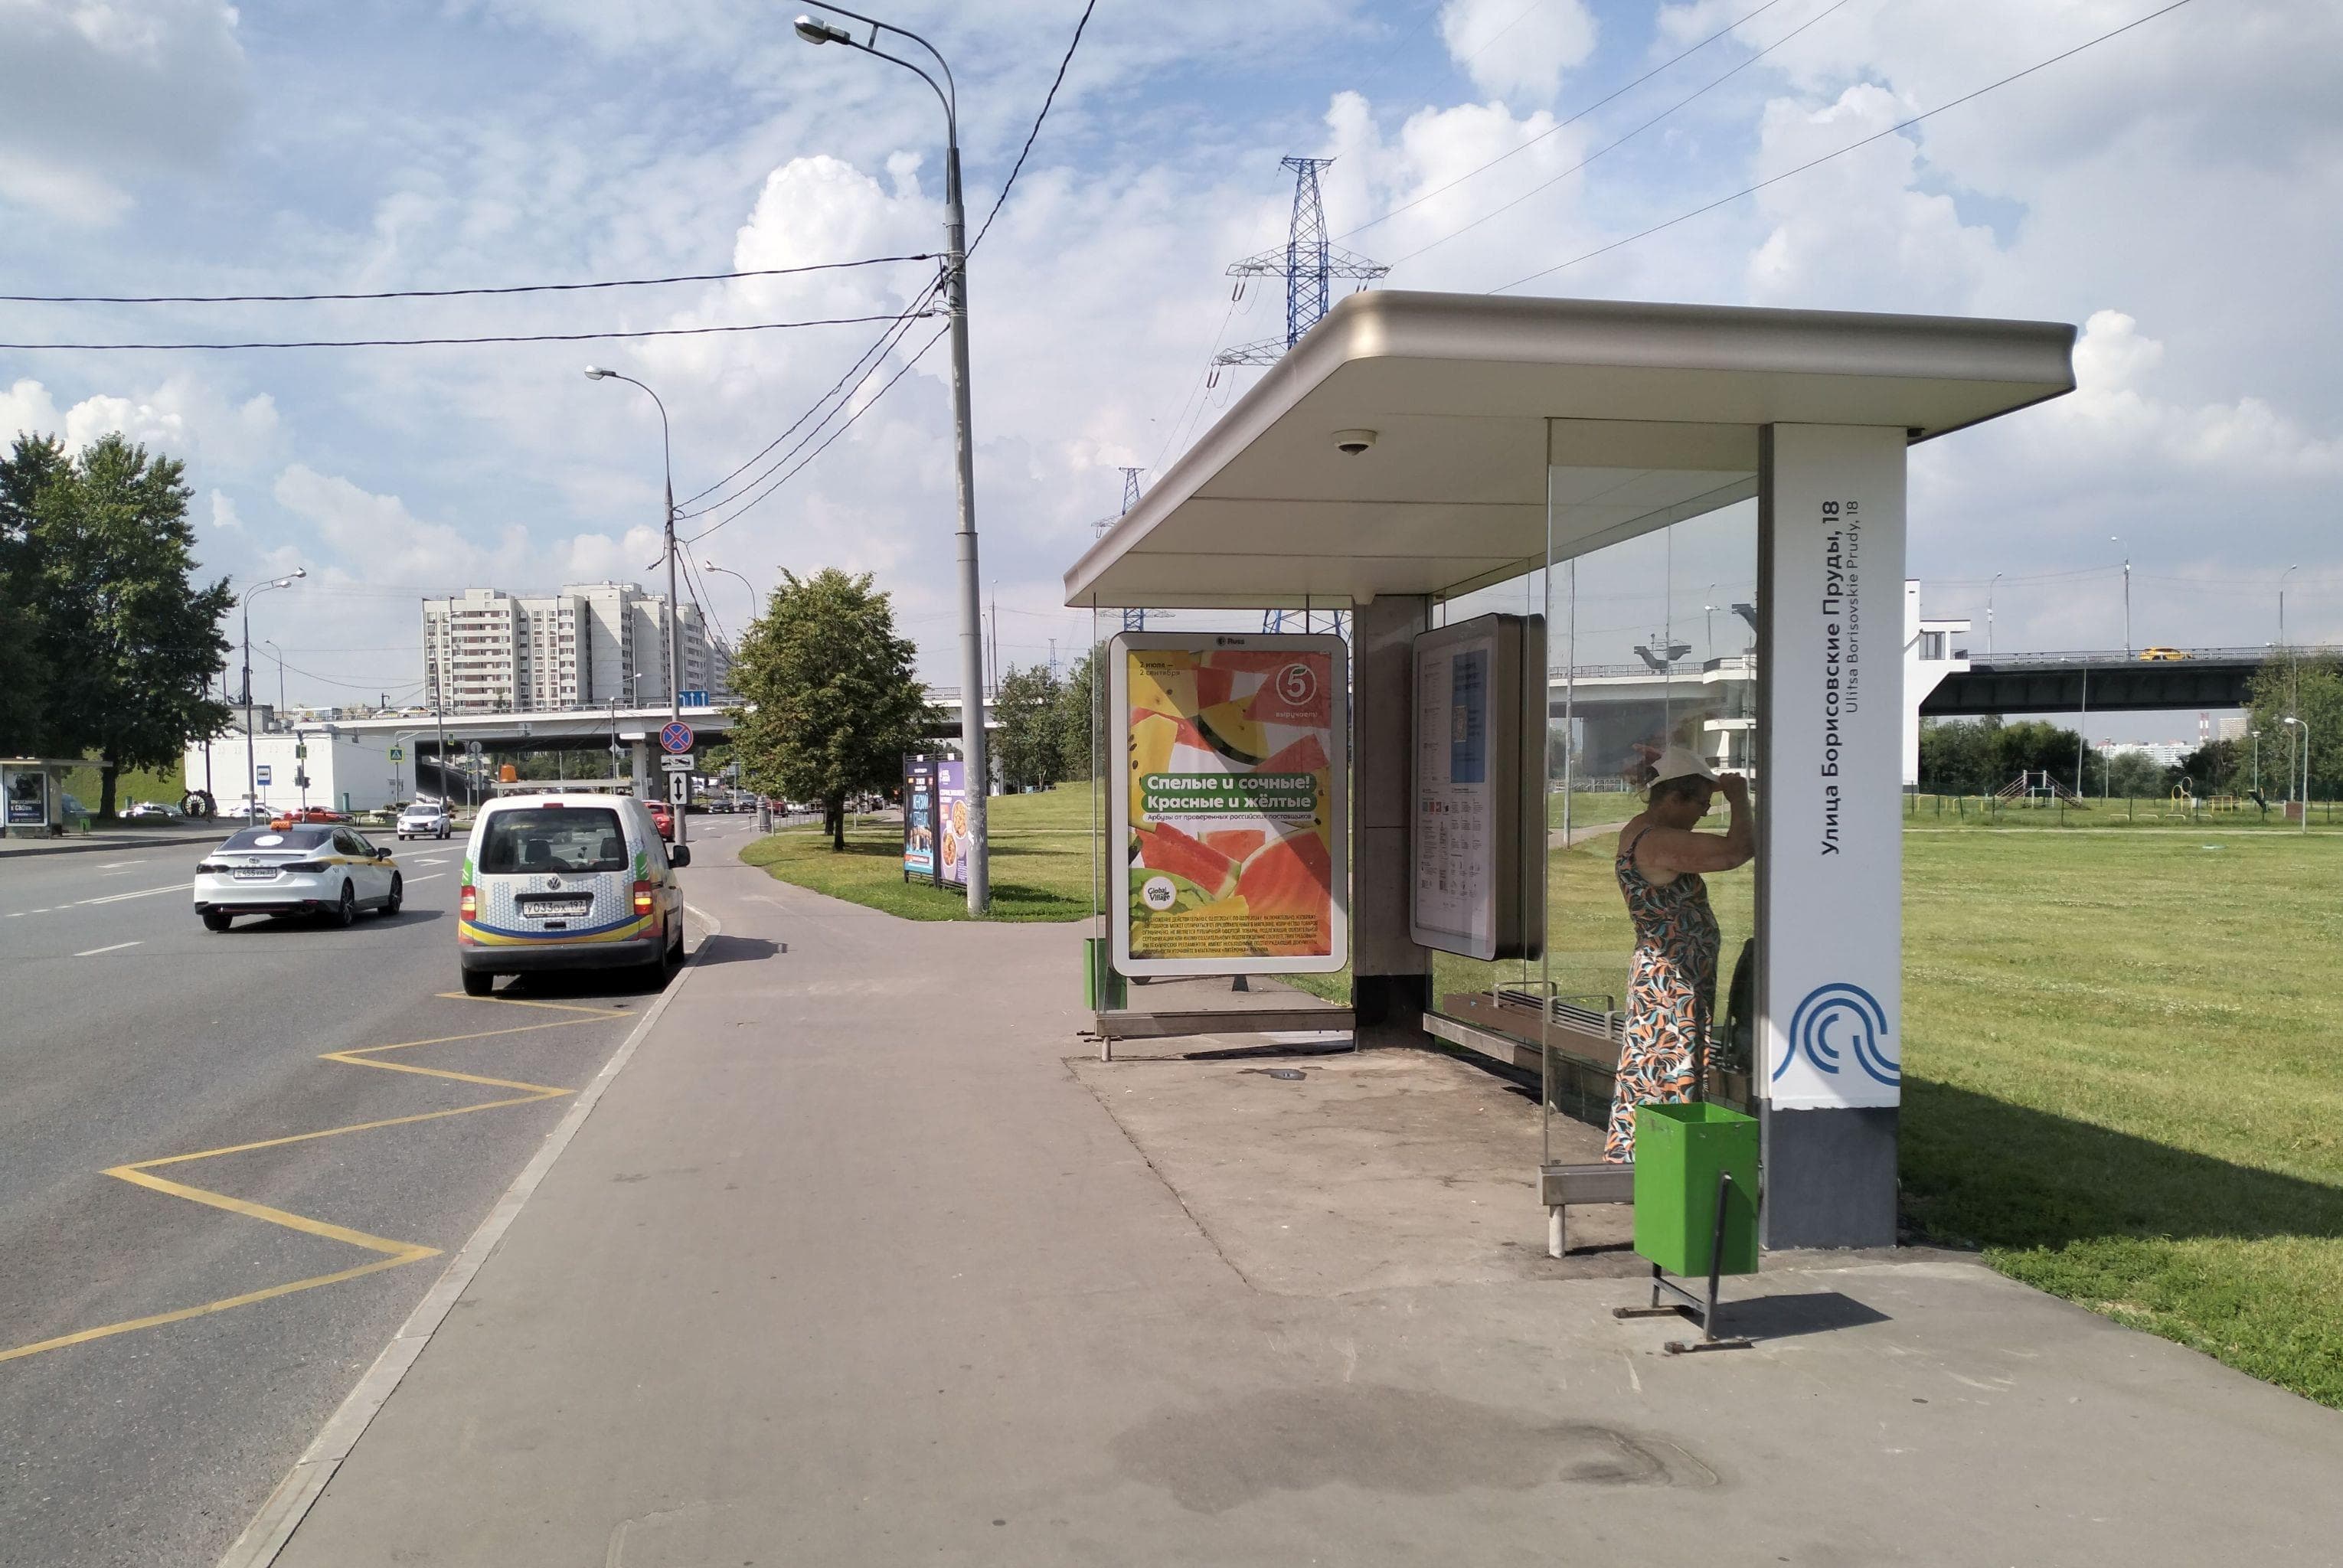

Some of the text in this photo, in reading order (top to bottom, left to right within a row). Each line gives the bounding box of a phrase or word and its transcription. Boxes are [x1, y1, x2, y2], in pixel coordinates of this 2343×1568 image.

[1845, 501, 1861, 713] Ulitsa Borisovskie Prudy, 18
[1145, 668, 1181, 678] сентября
[1821, 501, 1844, 855] Улица Борисовские Пруды, 18
[1147, 776, 1311, 790] Спелые и сочные!
[1148, 793, 1312, 812] Красные и жёлтые
[1149, 893, 1171, 902] Village
